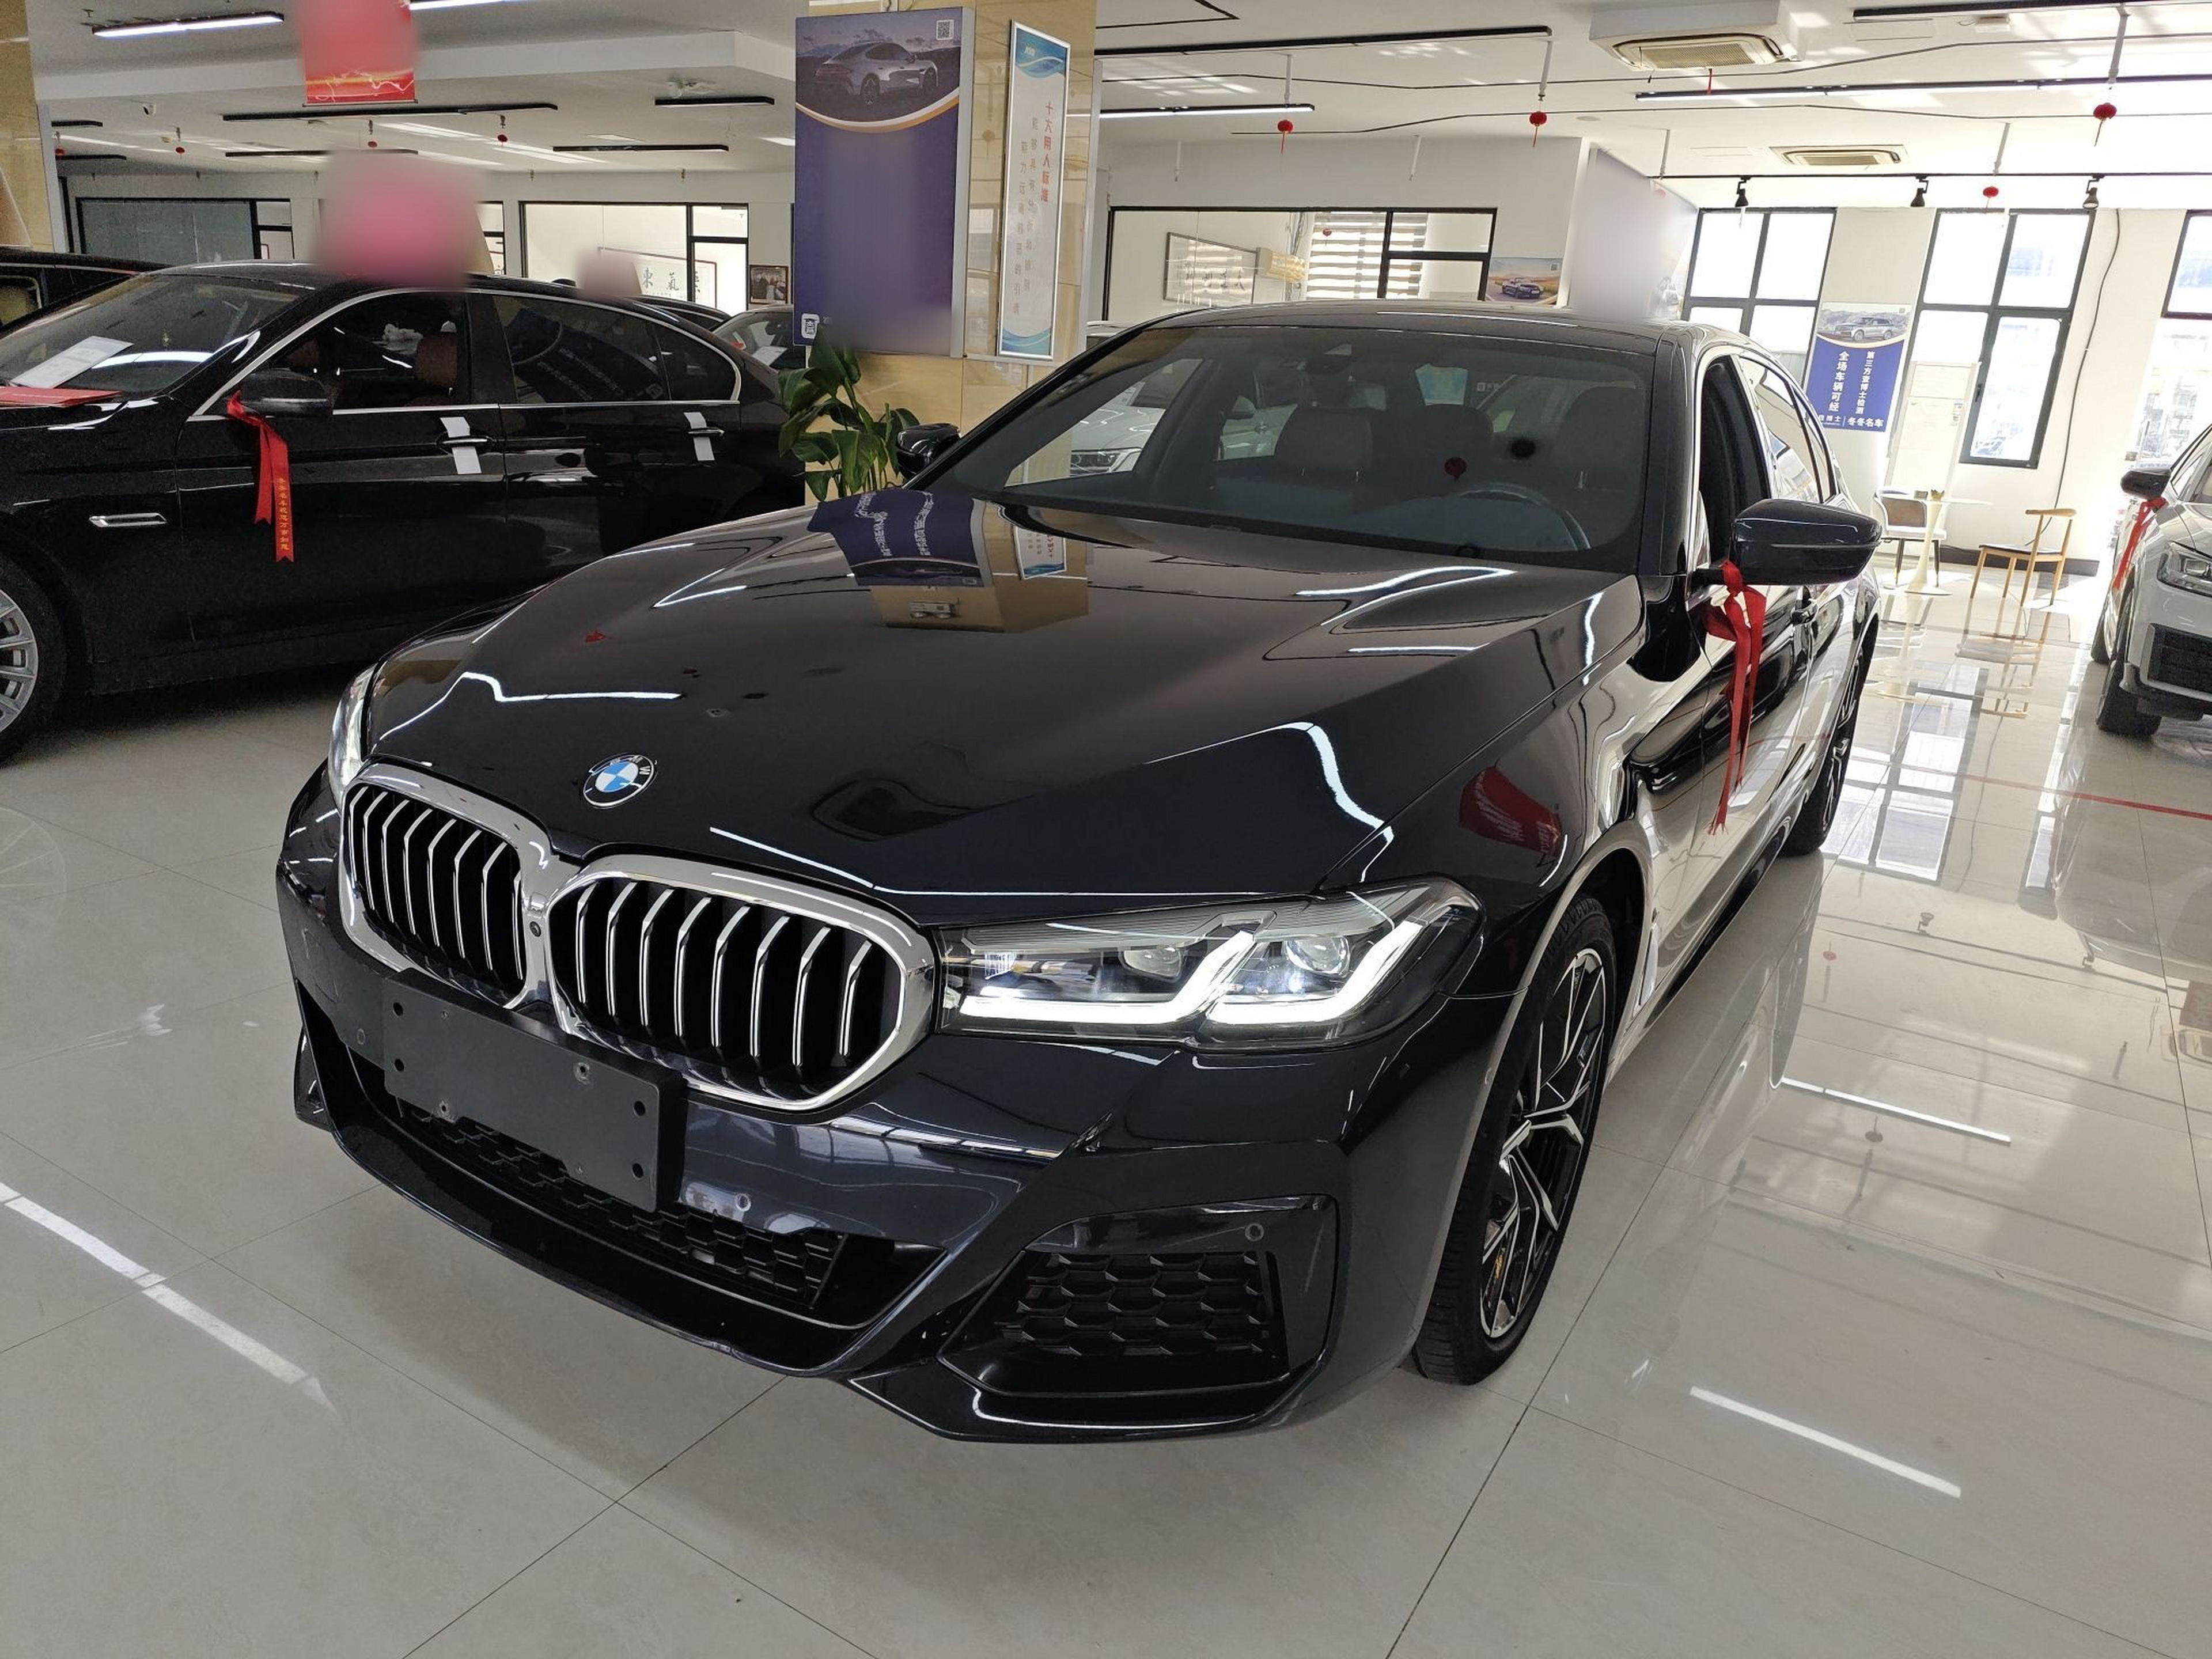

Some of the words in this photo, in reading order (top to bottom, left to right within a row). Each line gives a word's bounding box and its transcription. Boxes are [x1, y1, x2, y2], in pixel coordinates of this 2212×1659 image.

[1828, 351, 1850, 412] 全场车辆可经
[1847, 416, 1884, 428] 冬冬名车
